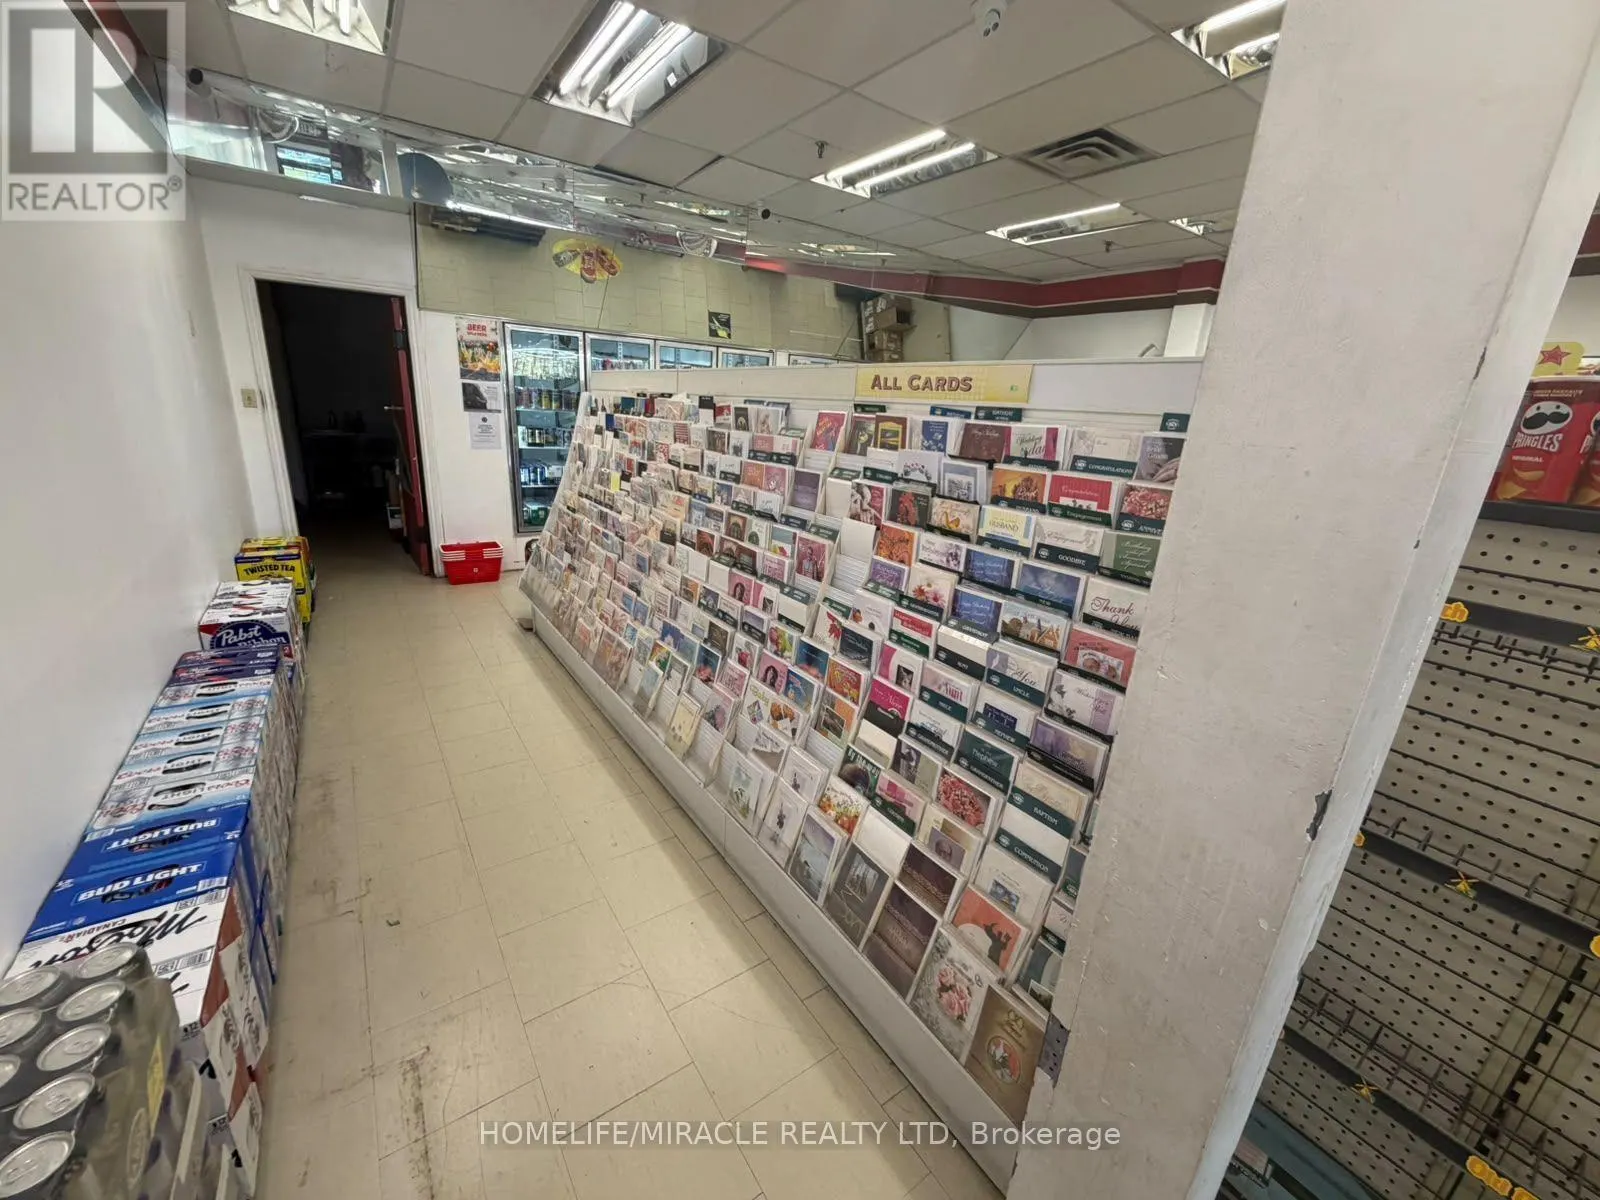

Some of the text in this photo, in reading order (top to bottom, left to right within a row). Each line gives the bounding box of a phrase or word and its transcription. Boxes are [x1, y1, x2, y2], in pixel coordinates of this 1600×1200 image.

[468, 324, 487, 332] BEER
[871, 374, 973, 392] ALL CARDS
[1512, 432, 1564, 452] PRINGLES
[243, 564, 296, 576] TWISTED TEA
[1091, 596, 1135, 616] Thank
[217, 626, 262, 647] Pabst
[1033, 807, 1058, 825] BAPTISM
[106, 818, 218, 850] BUD LIGHT
[78, 864, 204, 902] BUD LIGHT
